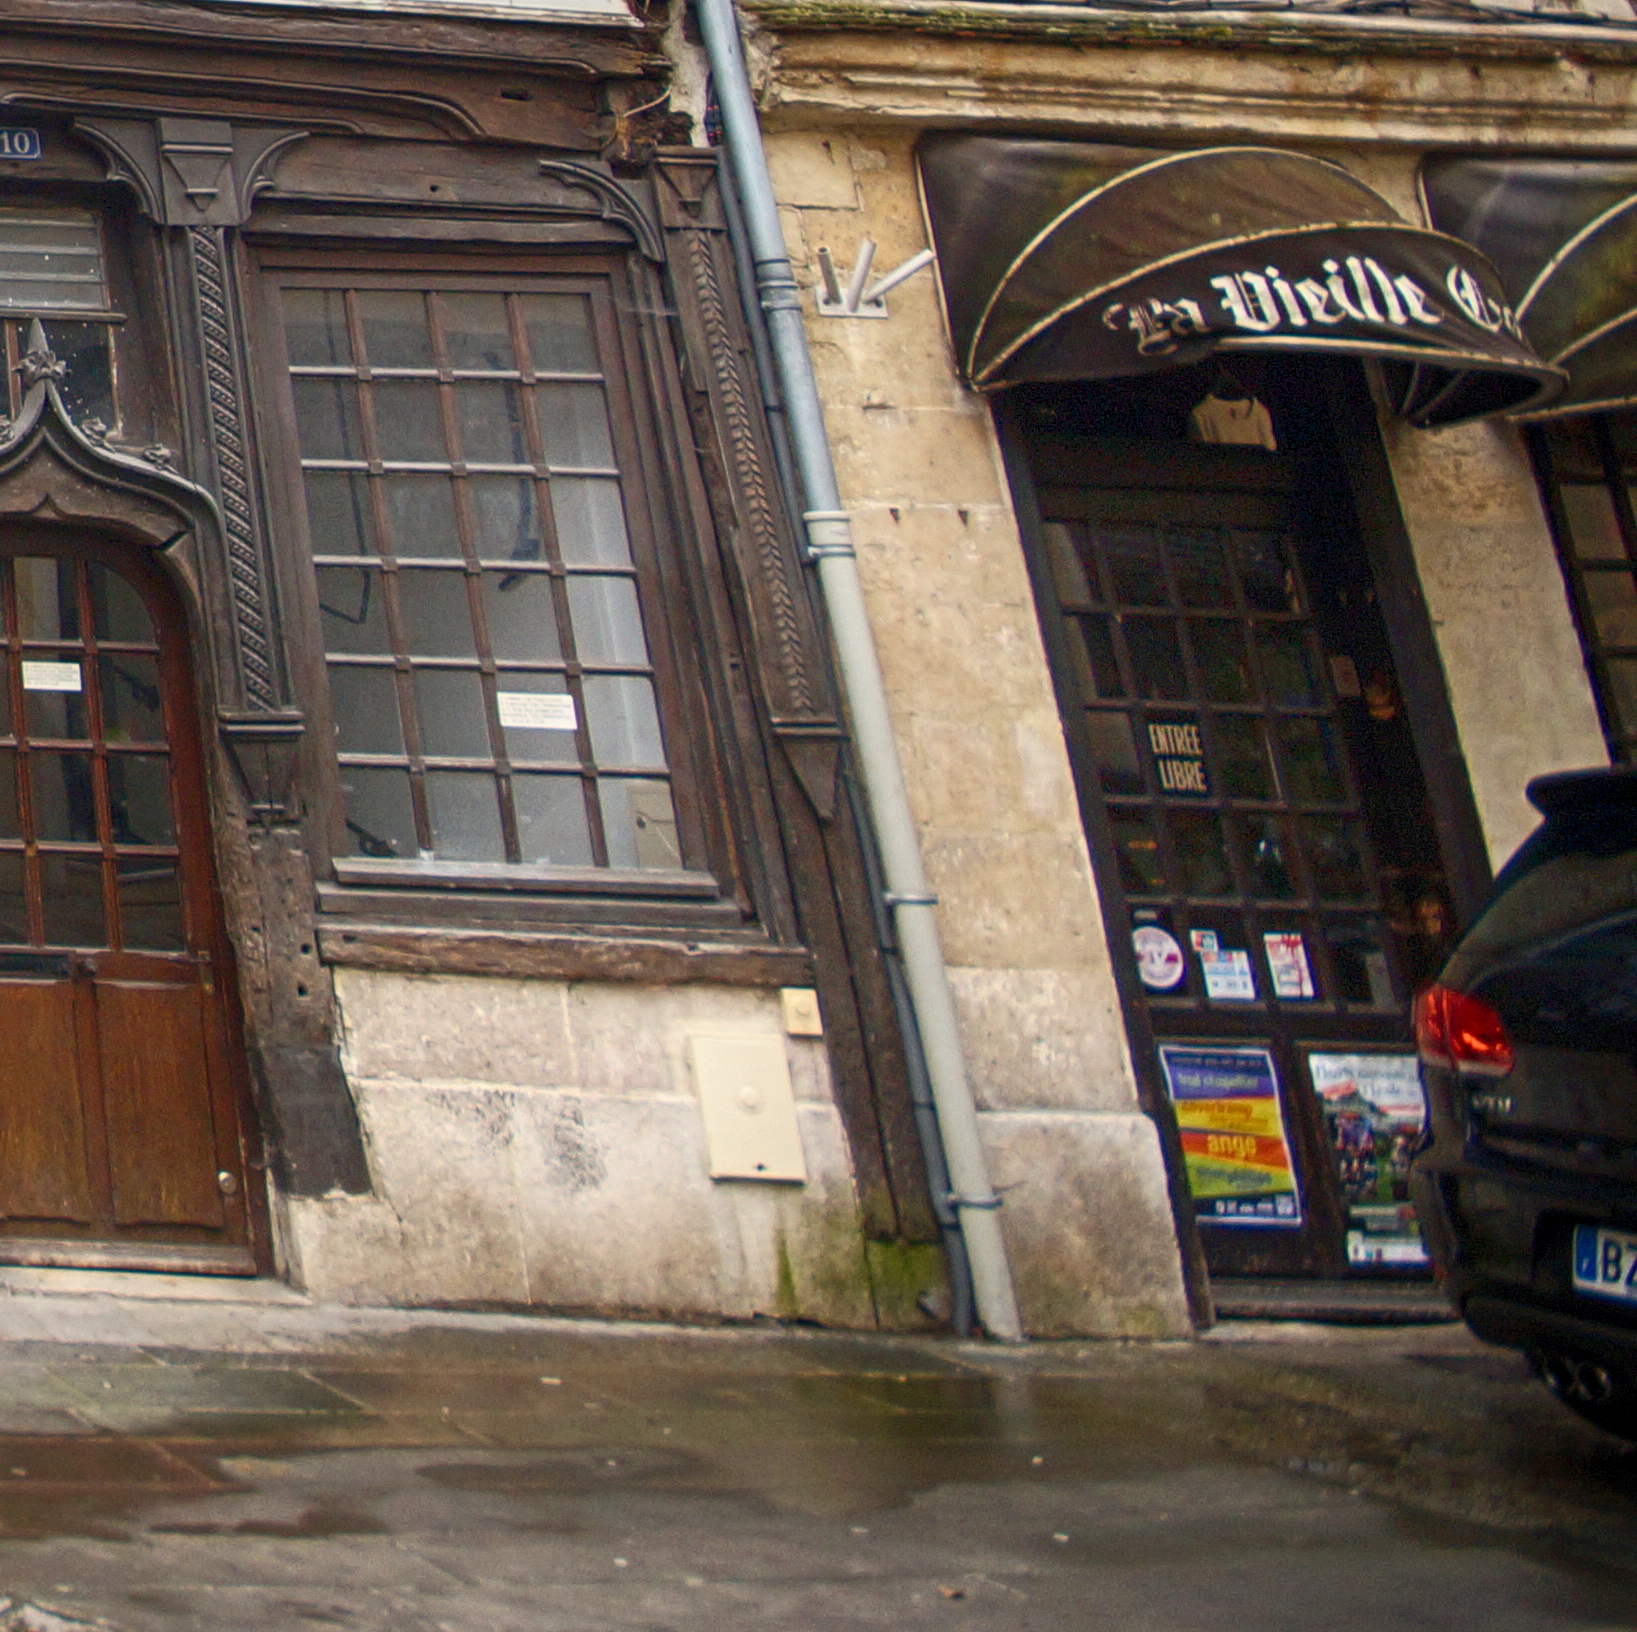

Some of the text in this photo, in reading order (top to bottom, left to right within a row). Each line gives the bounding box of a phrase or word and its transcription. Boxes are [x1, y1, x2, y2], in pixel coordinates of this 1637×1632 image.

[0, 130, 31, 155] 10
[1209, 255, 1446, 332] Vieille
[1159, 760, 1207, 791] LIBRE
